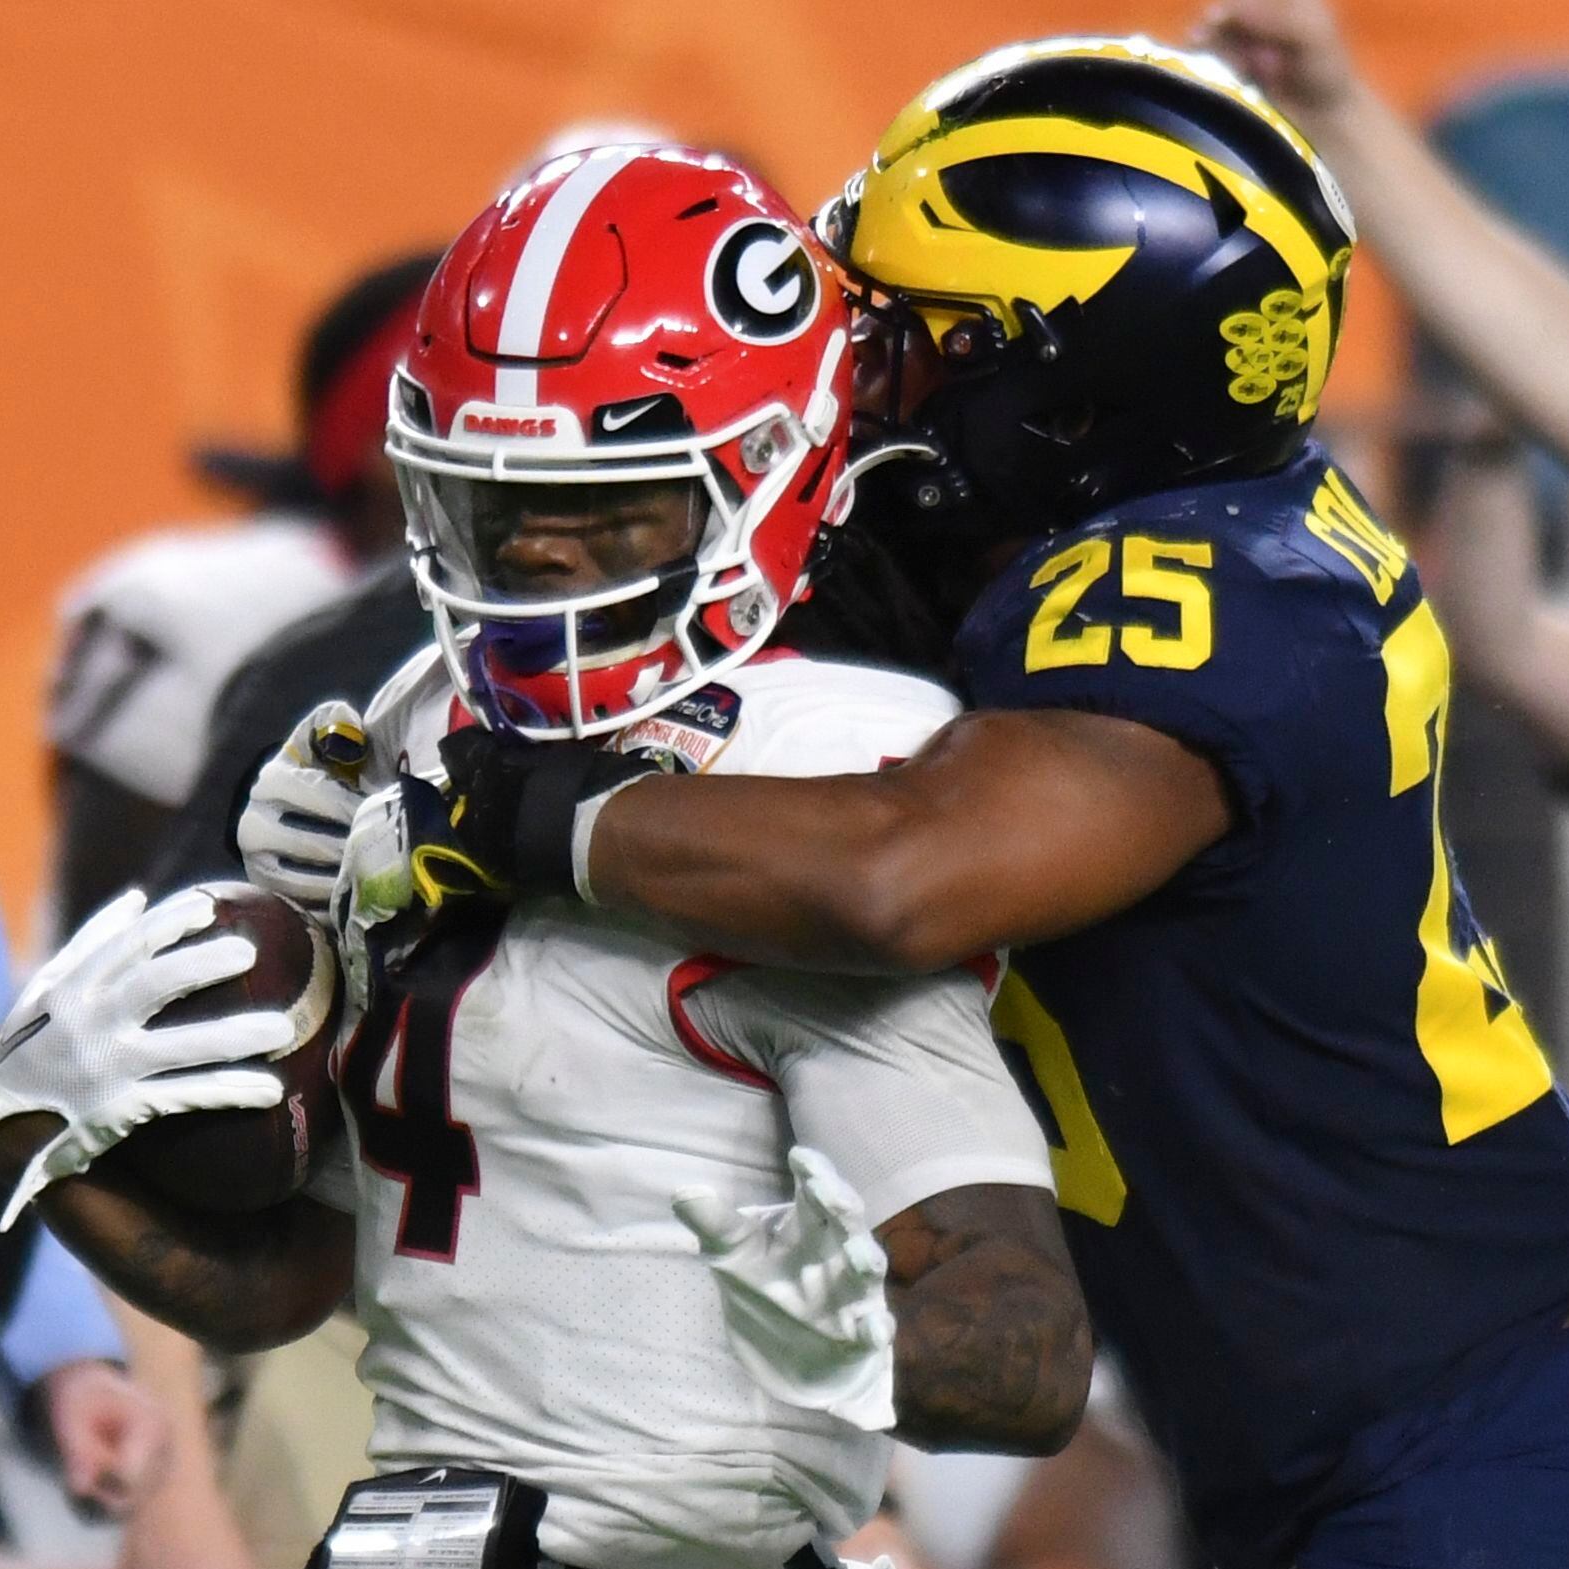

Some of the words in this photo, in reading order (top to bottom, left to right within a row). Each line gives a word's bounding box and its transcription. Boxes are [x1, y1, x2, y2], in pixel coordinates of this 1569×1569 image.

[707, 218, 819, 343] G
[463, 413, 557, 437] DAWGS
[1025, 534, 1216, 675] 25
[674, 730, 711, 764] BOWL
[336, 895, 516, 1264] 4
